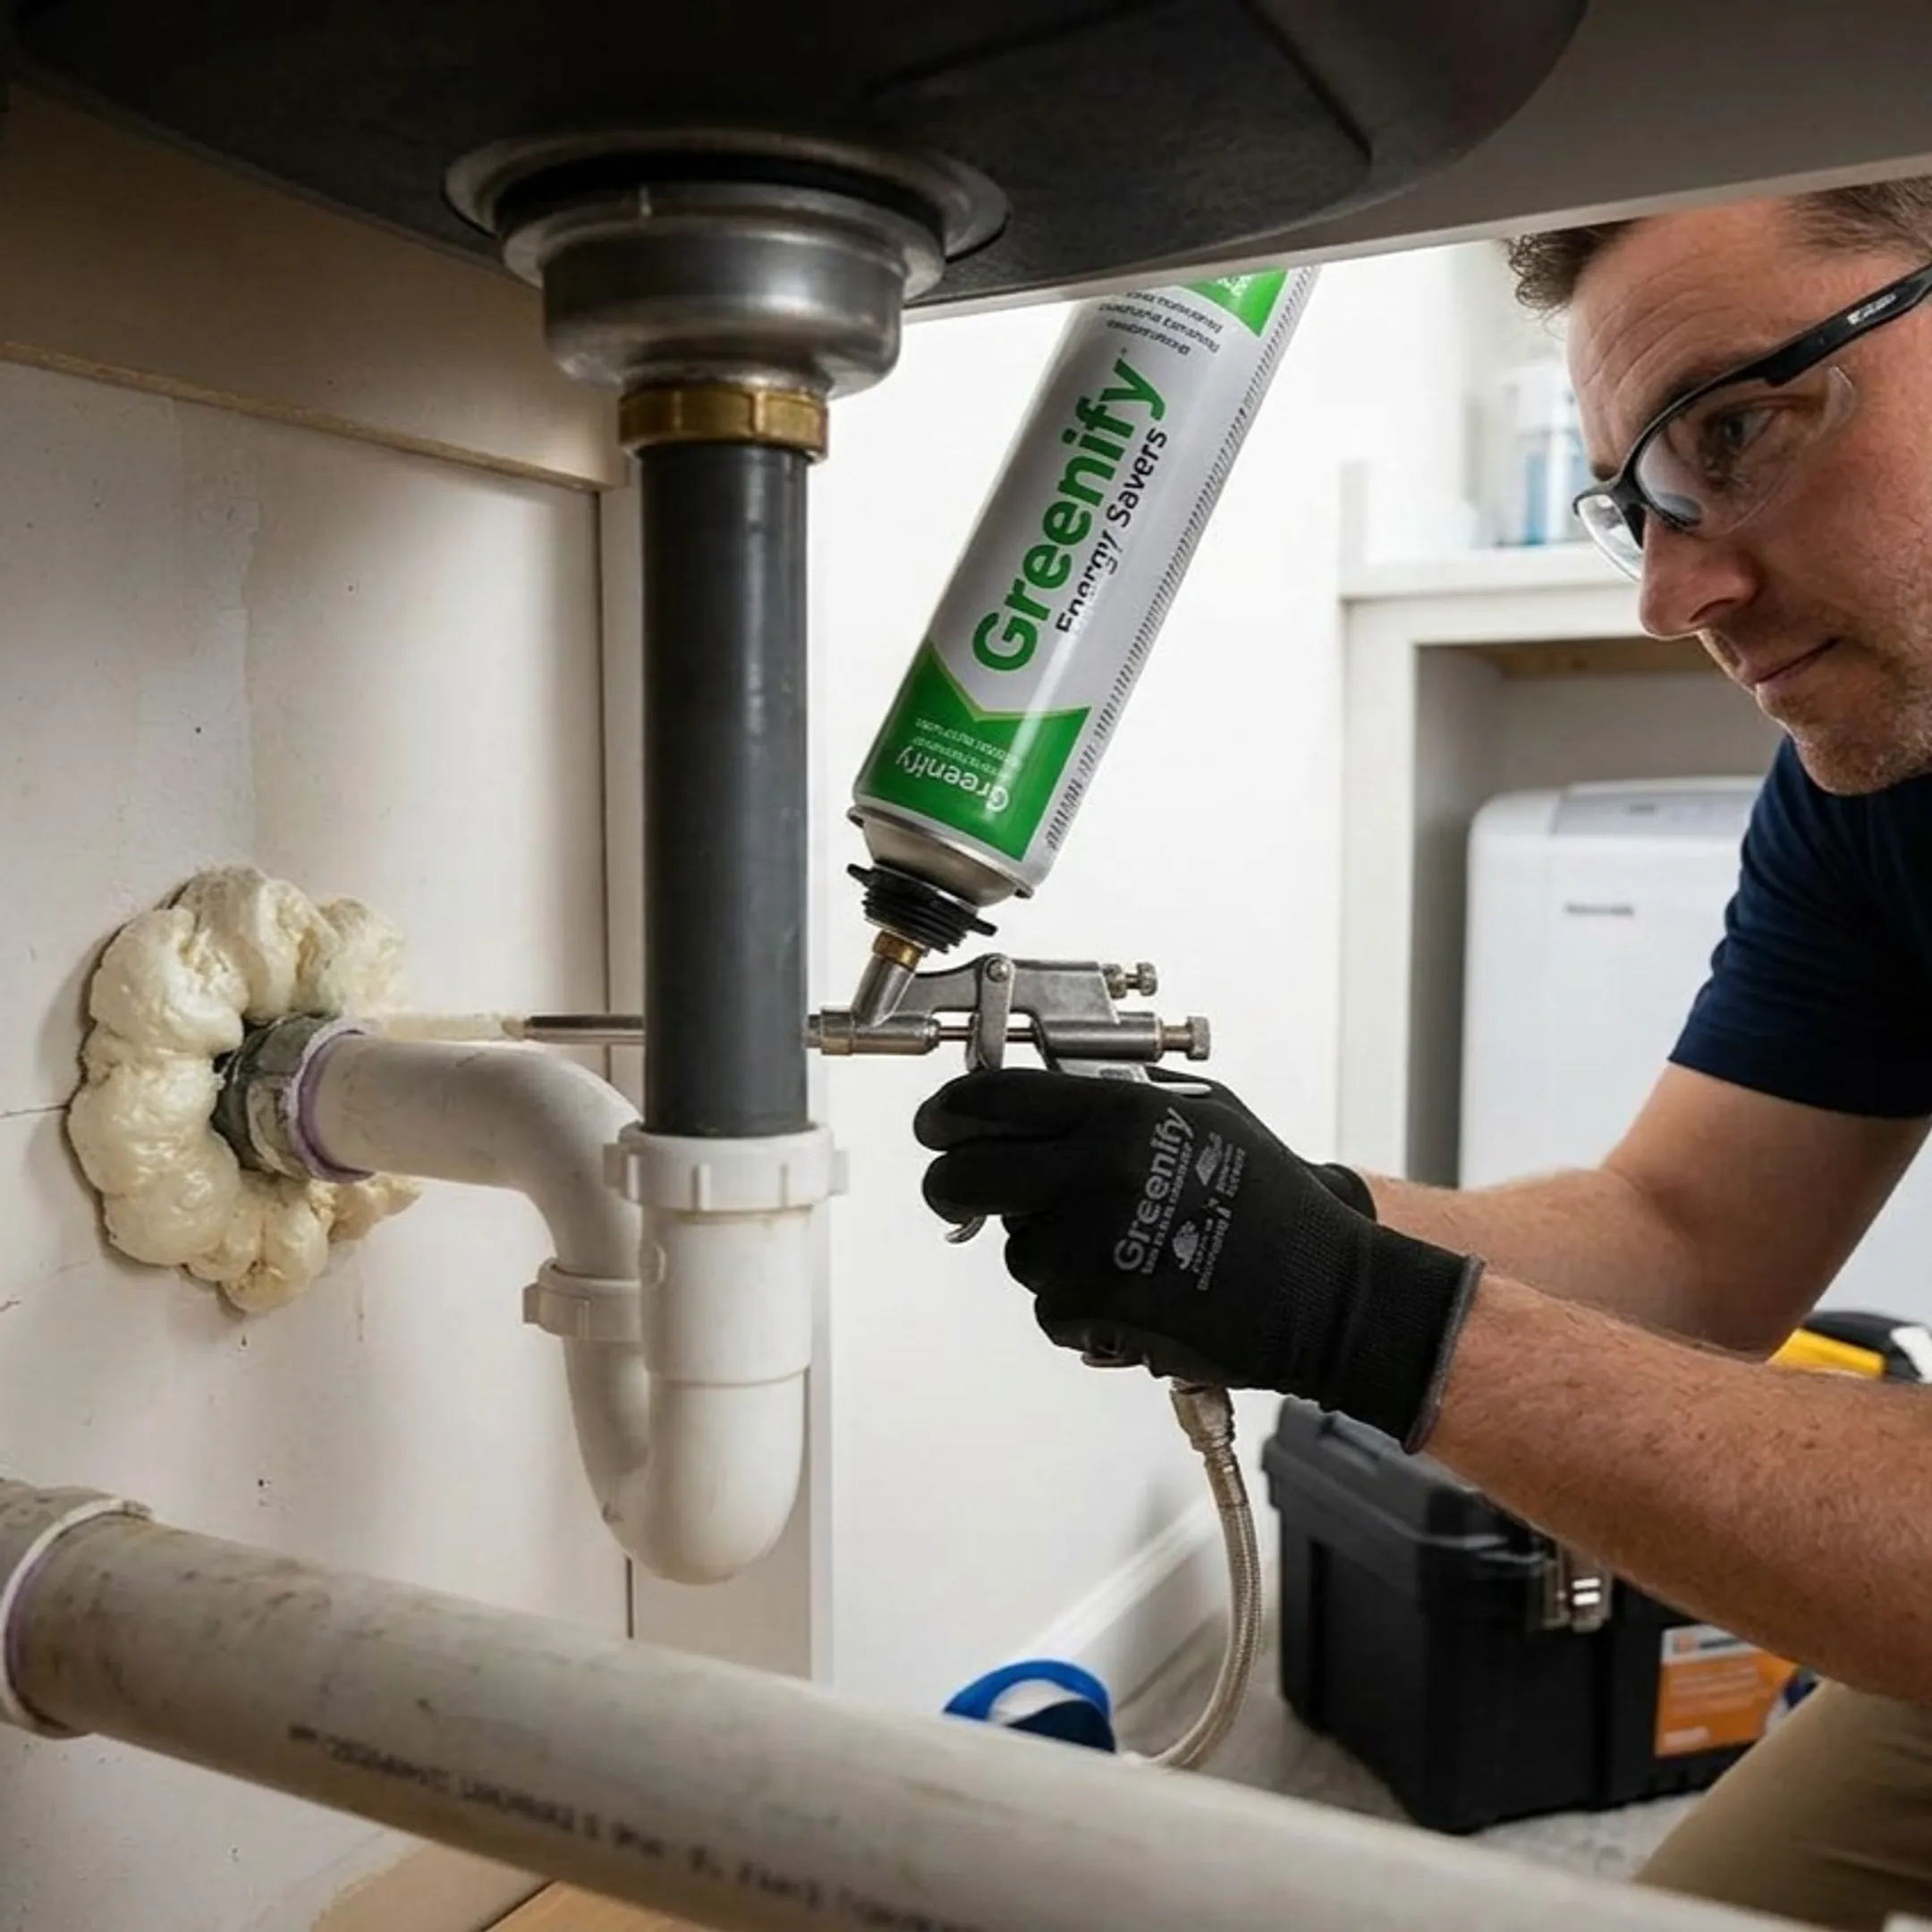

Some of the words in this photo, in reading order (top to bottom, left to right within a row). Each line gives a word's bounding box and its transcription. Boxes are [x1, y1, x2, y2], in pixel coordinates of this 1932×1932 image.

[972, 359, 1166, 671] Greenify
[1106, 428, 1168, 528] Savers
[896, 746, 1010, 812] Greenify
[1114, 1106, 1195, 1271] Greenify
